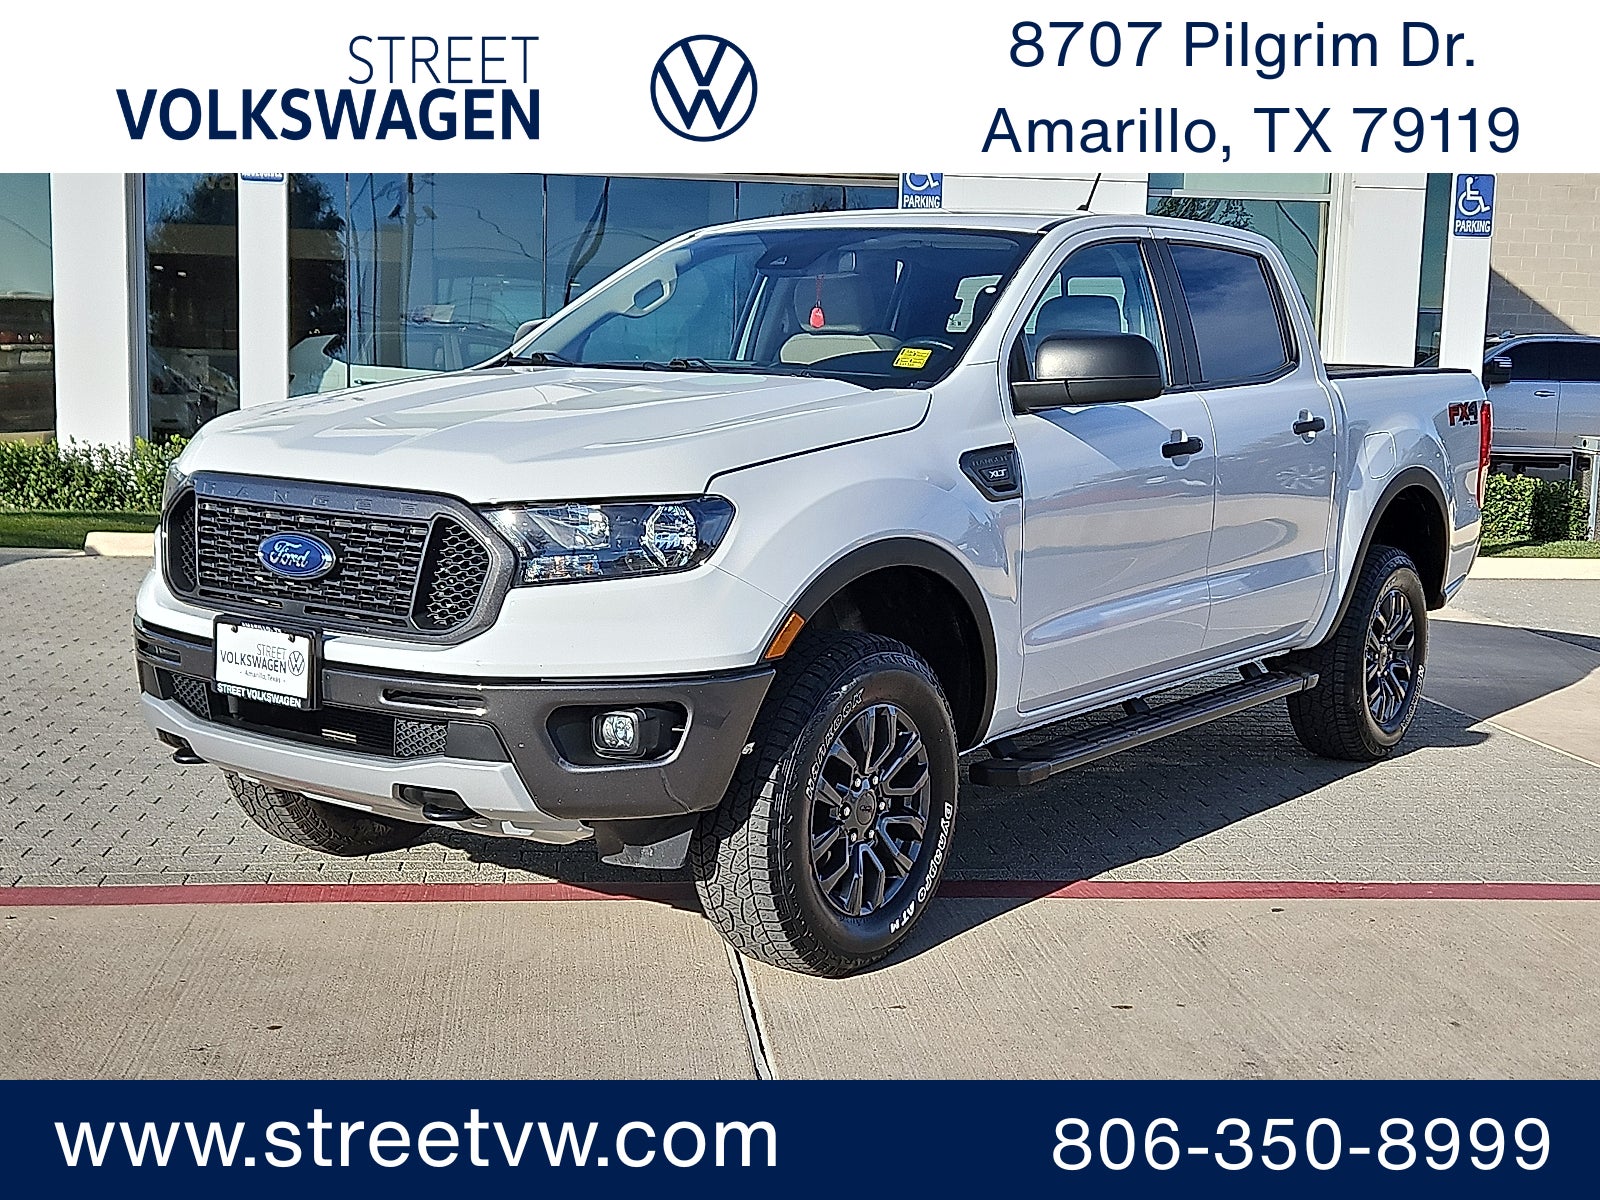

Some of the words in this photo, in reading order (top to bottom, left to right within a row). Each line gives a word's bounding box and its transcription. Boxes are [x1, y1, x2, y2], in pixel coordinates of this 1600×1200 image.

[903, 194, 940, 208] PARKING
[1455, 219, 1491, 233] PARKING
[1449, 401, 1478, 426] FX4
[988, 468, 1007, 478] XLT
[269, 540, 311, 568] Ford
[220, 649, 287, 674] VOLKSWAGEN
[256, 643, 287, 660] STREET
[217, 682, 247, 697] STREET
[246, 688, 301, 708] VOLKSWAGEN
